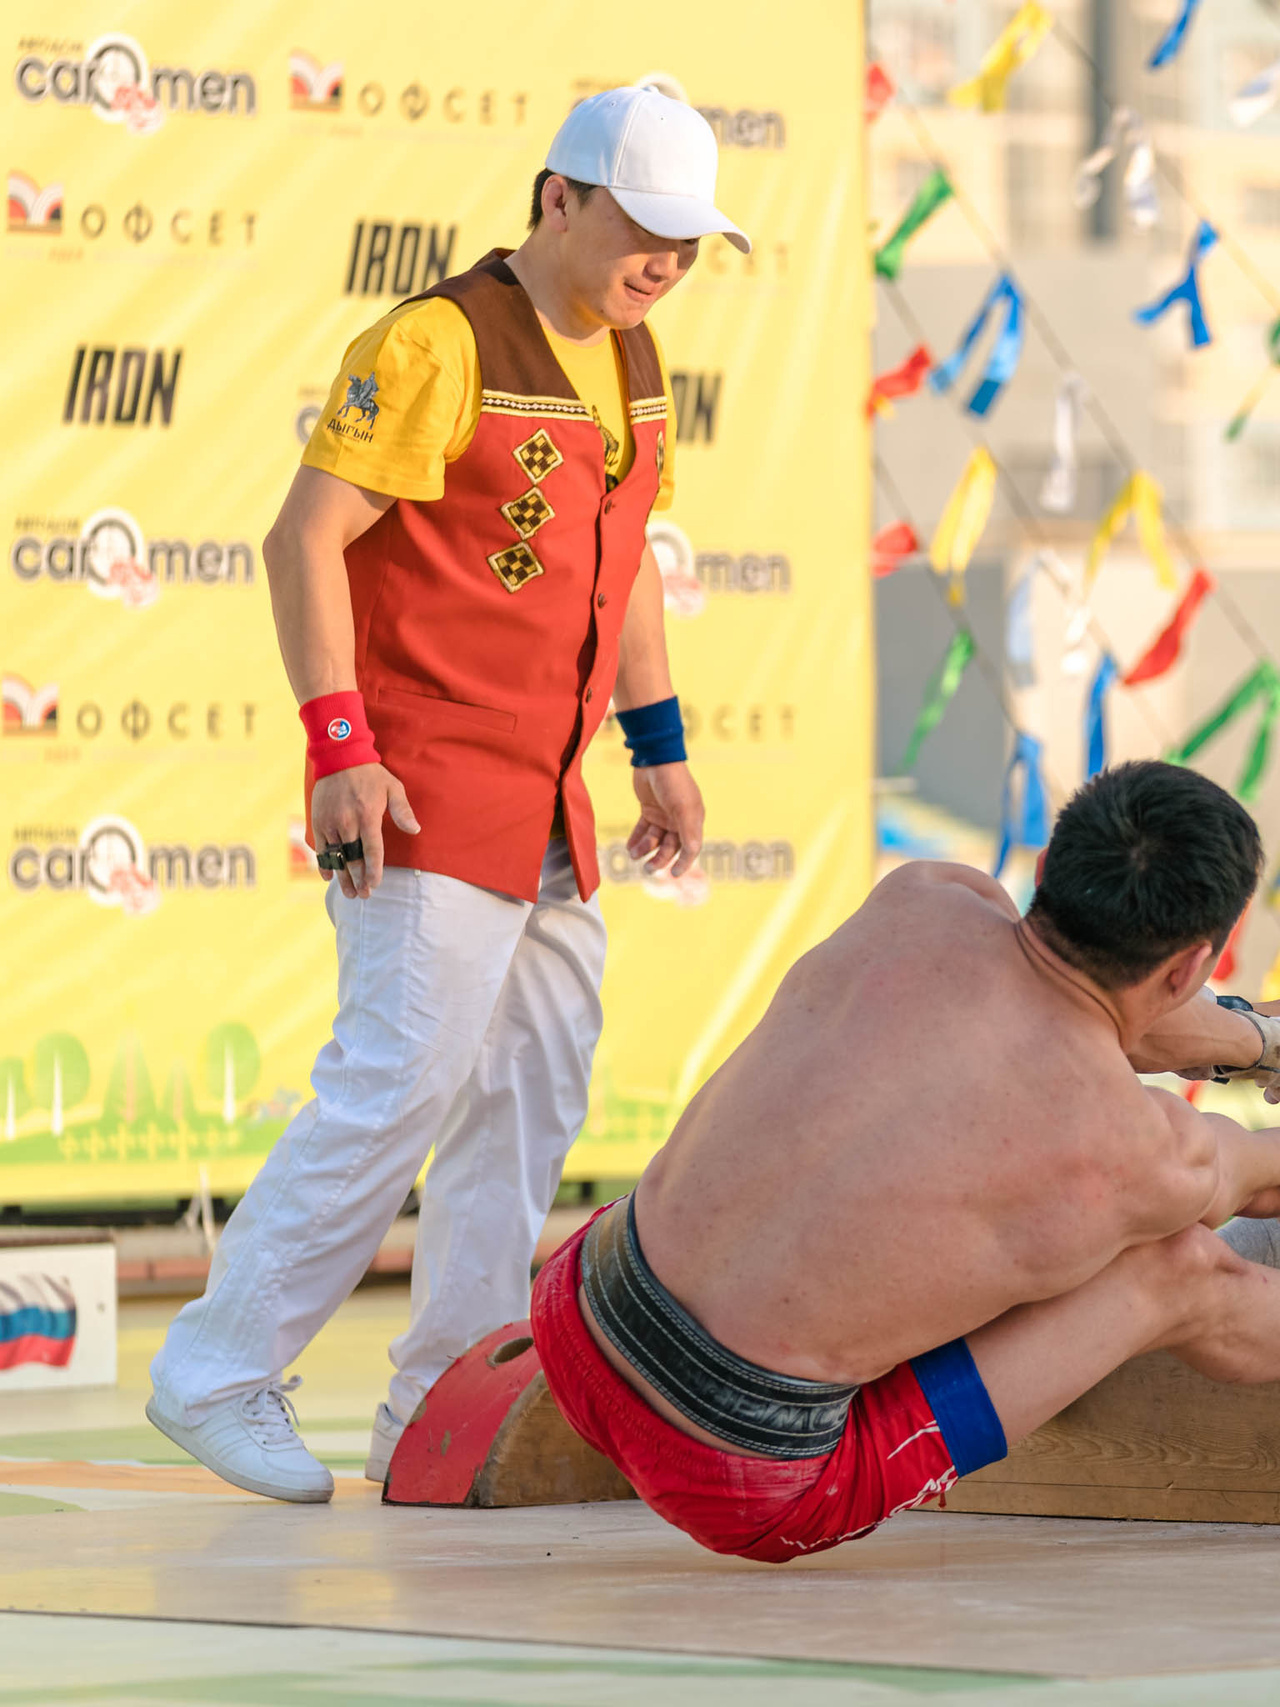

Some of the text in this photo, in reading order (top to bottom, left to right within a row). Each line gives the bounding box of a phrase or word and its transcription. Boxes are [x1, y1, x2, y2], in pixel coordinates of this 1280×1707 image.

[358, 83, 527, 126] ОФСЕТ
[81, 203, 258, 246] ОФСЕТ
[345, 221, 457, 294] IRON
[63, 345, 183, 425] IRON
[670, 373, 723, 442] ON
[77, 699, 258, 741] ОФСЕТ
